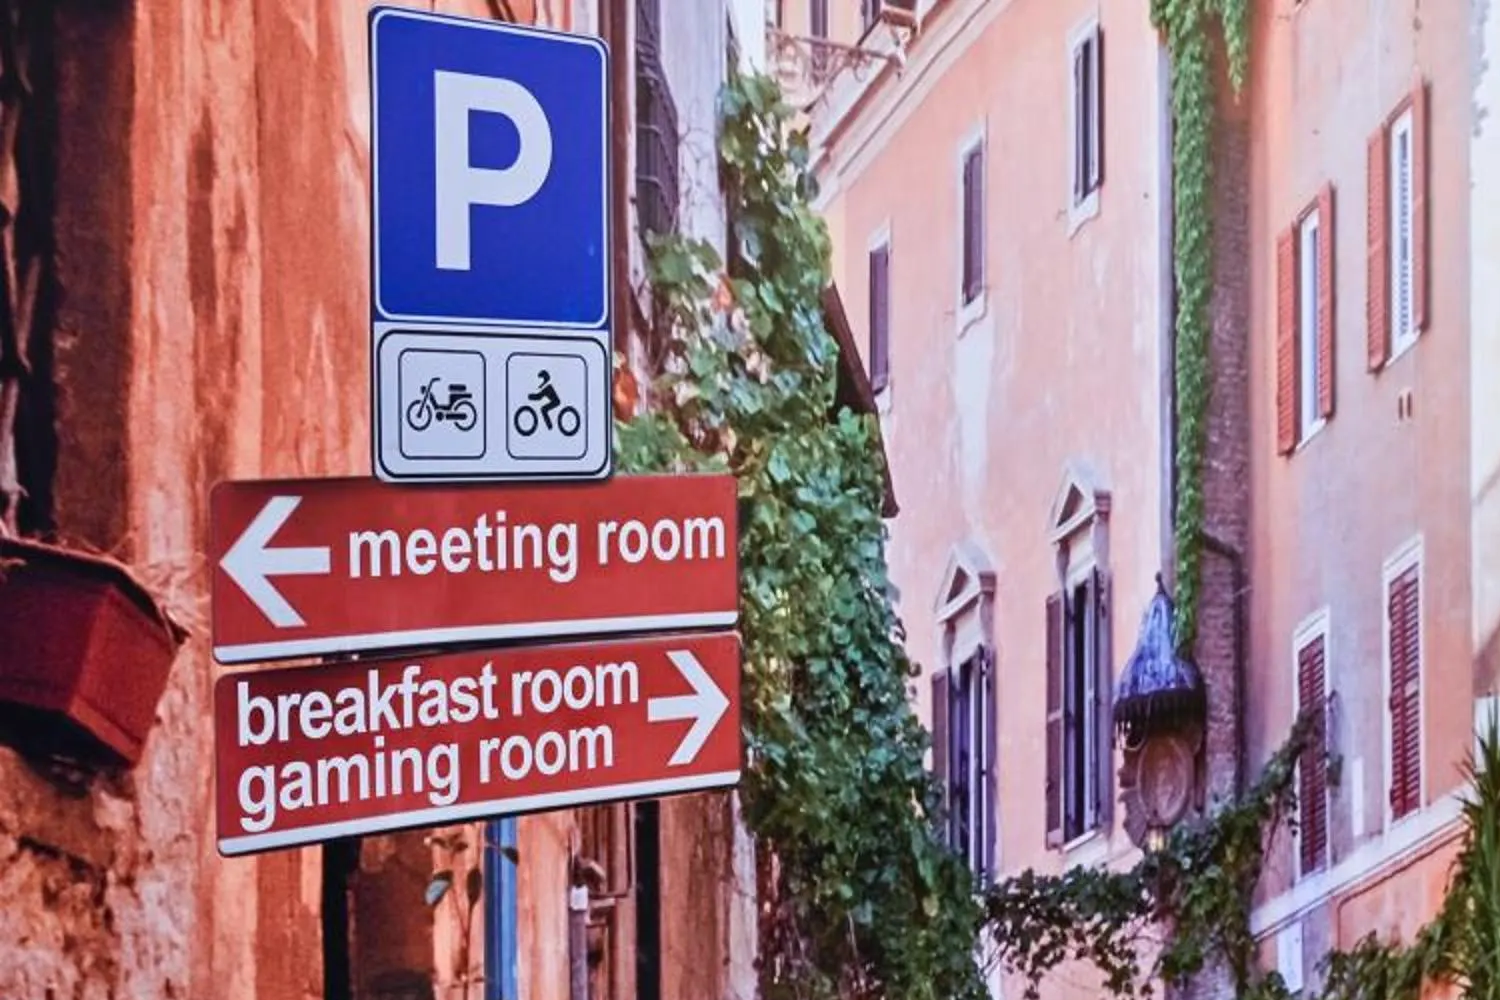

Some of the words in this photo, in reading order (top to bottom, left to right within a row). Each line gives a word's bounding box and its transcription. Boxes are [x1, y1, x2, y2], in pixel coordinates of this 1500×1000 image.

[434, 69, 553, 271] P
[349, 510, 578, 583] meeting
[598, 516, 725, 565] room
[237, 661, 499, 746] breakfast
[511, 661, 639, 716] room
[238, 735, 460, 833] gaming
[479, 725, 613, 784] room
